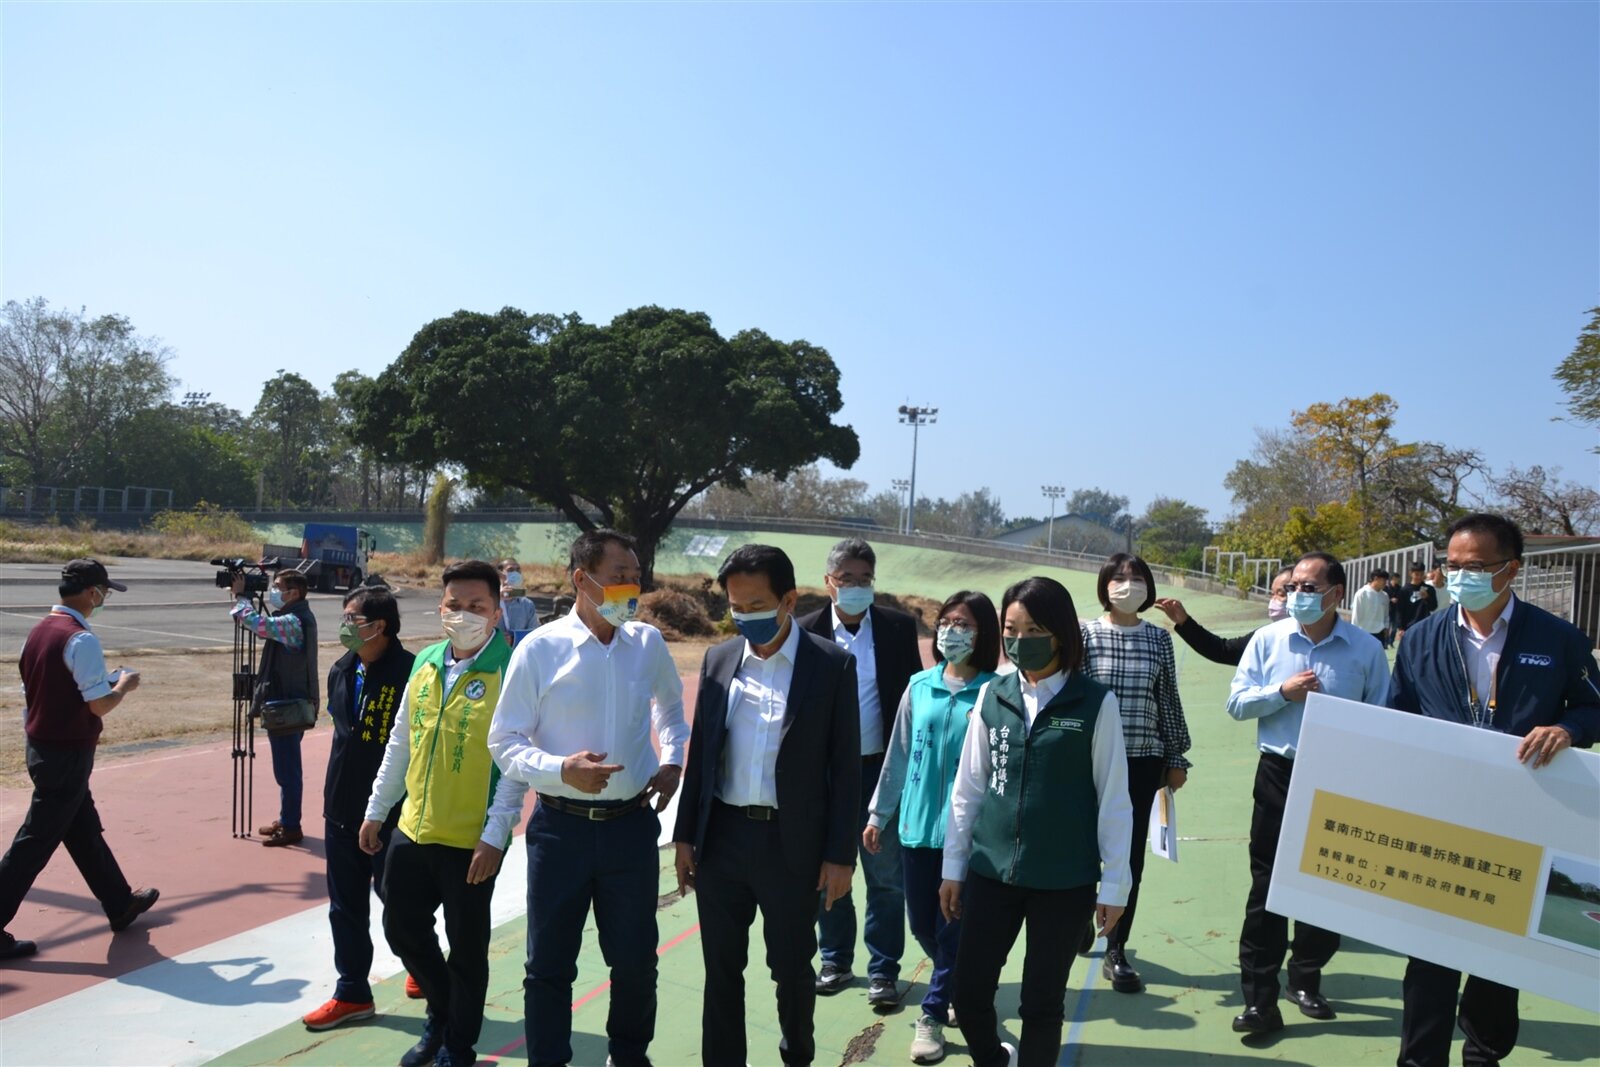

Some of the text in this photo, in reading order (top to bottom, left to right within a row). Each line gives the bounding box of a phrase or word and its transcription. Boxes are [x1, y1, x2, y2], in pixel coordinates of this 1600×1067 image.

[996, 725, 1010, 797] 台南市議員
[1315, 863, 1387, 892] 112.02.07
[1323, 818, 1523, 883] 臺南市立自由車場拆除重建工程
